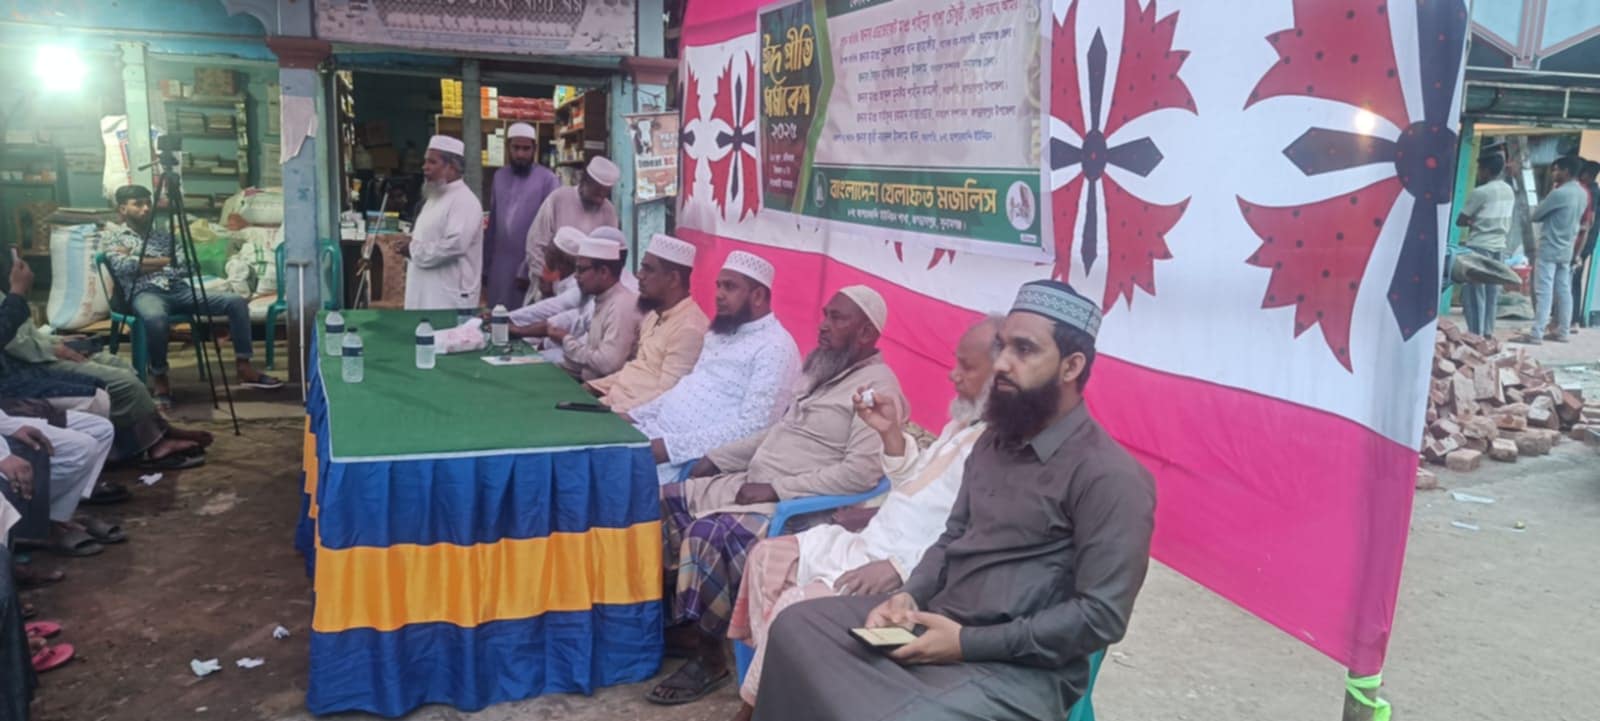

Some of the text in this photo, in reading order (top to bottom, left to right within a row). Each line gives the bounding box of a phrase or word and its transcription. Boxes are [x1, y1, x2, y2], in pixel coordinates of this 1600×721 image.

[784, 23, 815, 72] প্রীতি
[764, 84, 811, 118] সমাবেশ
[771, 122, 798, 141] ২০২৫
[830, 178, 997, 214] বাংলাদেশ খেলাফত মজলিস
